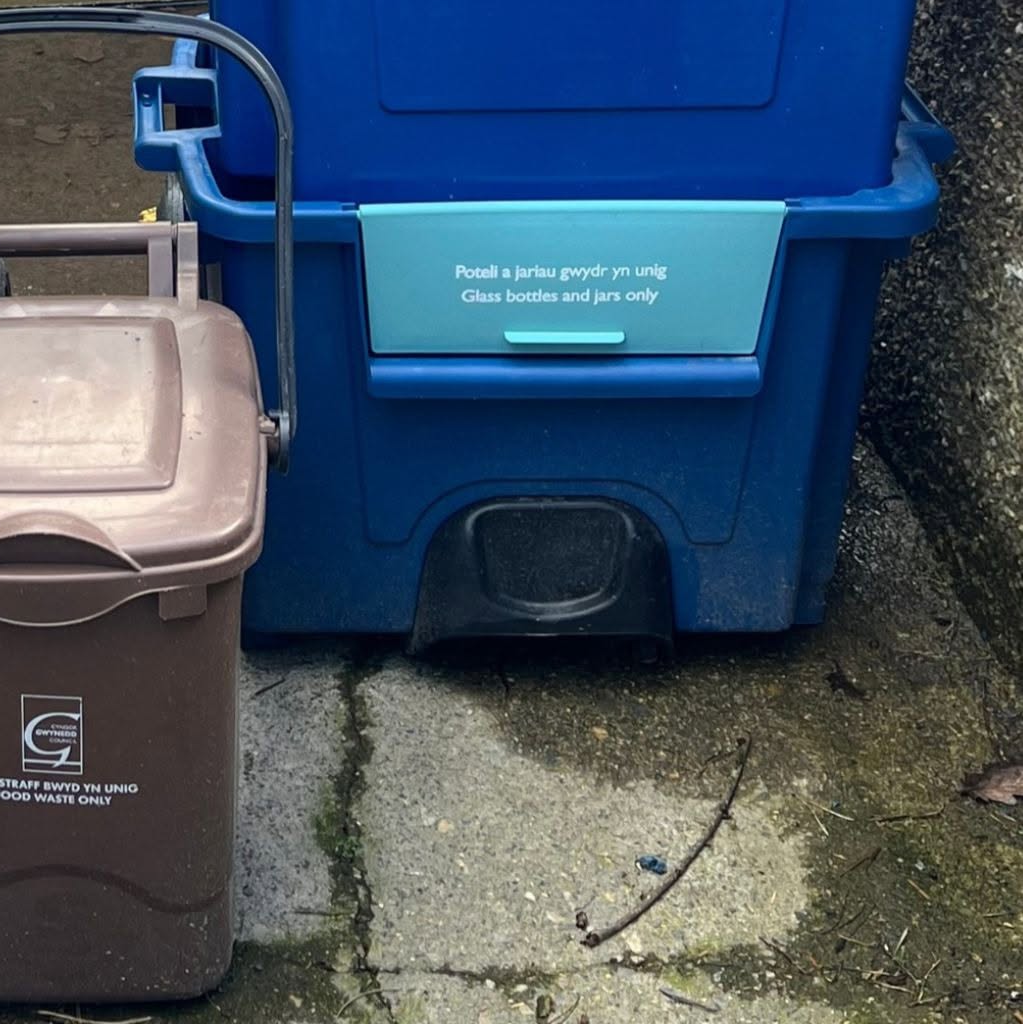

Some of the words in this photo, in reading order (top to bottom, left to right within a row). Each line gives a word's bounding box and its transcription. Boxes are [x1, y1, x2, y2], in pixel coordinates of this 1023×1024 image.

[454, 264, 498, 279] Poteli
[502, 268, 511, 279] a
[514, 264, 556, 282] jariau
[559, 263, 608, 282] gwydr
[612, 266, 630, 281] yn
[635, 263, 668, 281] unig
[461, 288, 502, 304] Glass
[505, 288, 559, 303] bottles
[562, 288, 591, 303] and
[593, 289, 621, 306] jars
[625, 287, 659, 305] only
[35, 728, 77, 738] GWYNEDD
[43, 780, 81, 794] BWYD
[83, 782, 101, 794] YN
[104, 783, 138, 795] UNIG
[34, 793, 75, 805] WASTE
[78, 794, 112, 806] ONLY
